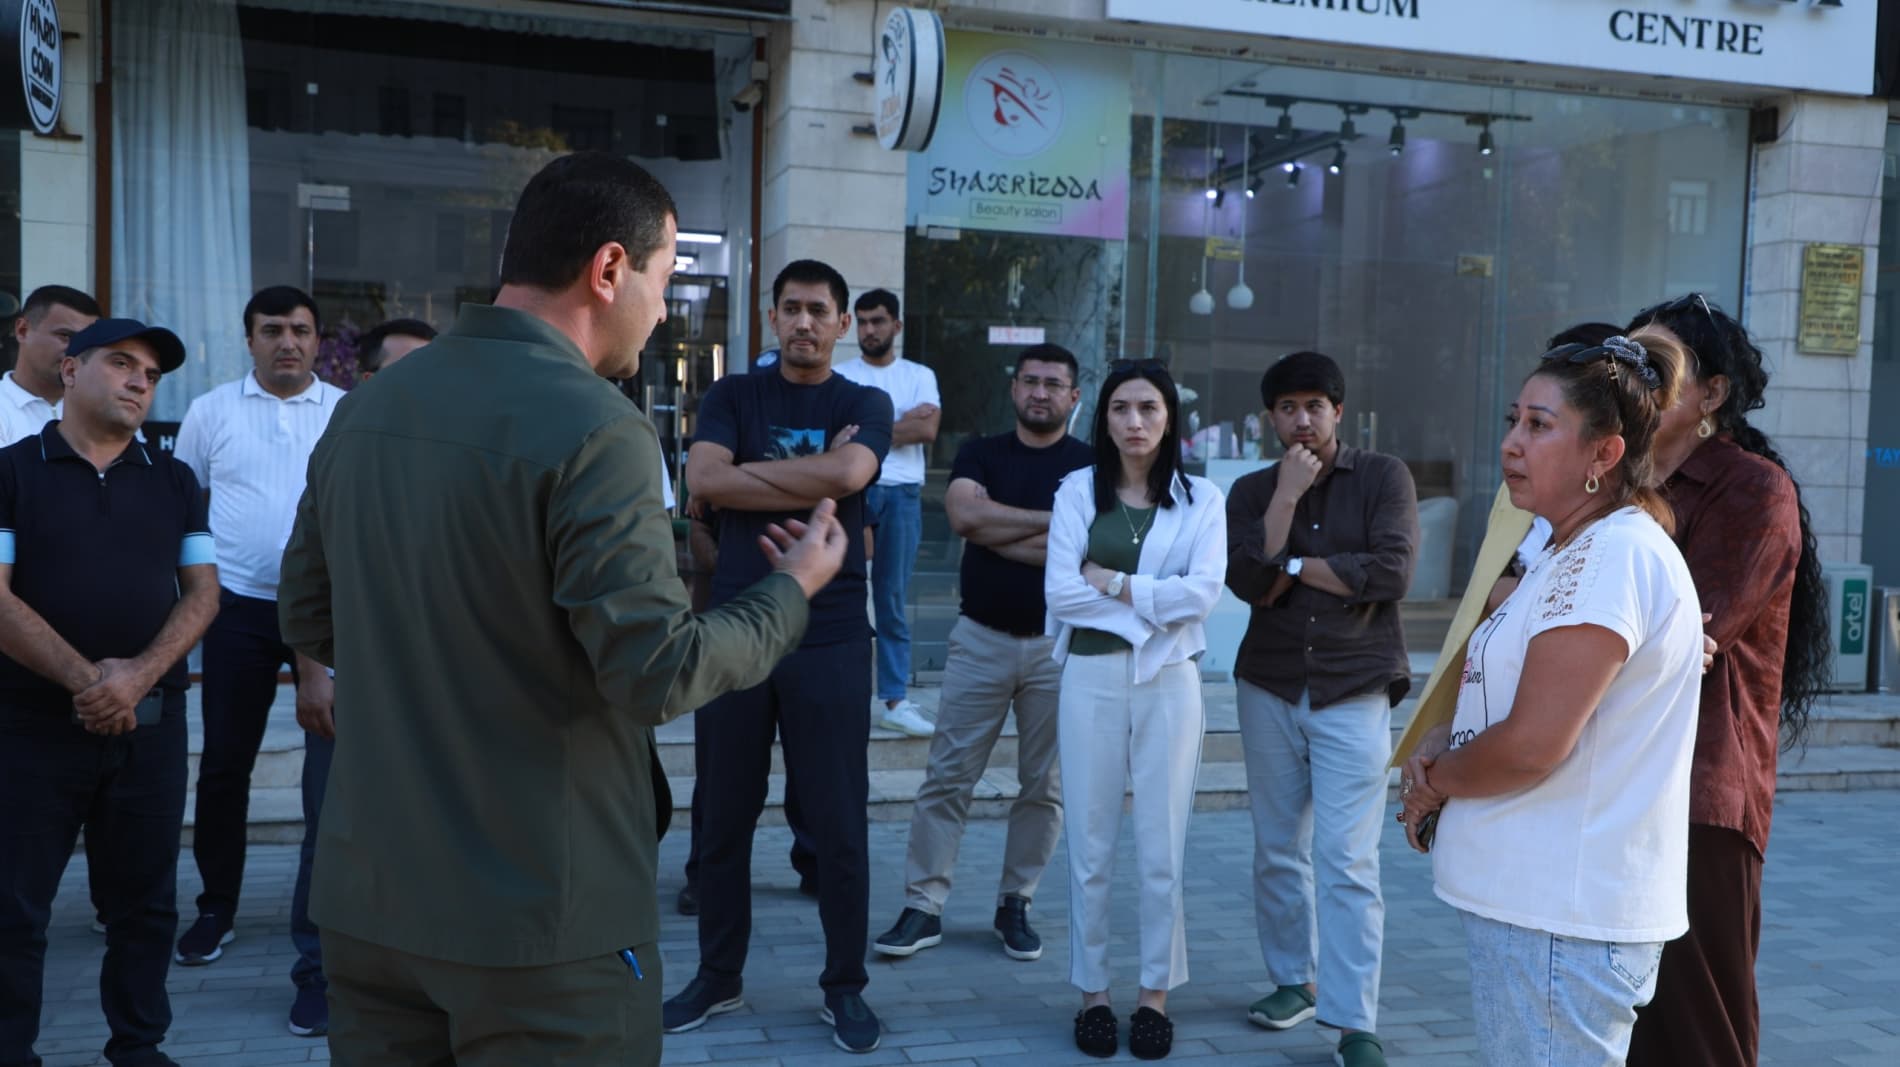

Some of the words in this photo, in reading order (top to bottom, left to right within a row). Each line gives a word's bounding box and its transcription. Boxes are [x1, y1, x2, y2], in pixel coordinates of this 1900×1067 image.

[1608, 8, 1764, 56] CENTRE
[31, 46, 54, 88] COIN
[975, 202, 1020, 218] Beauty
[1023, 206, 1057, 219] salon
[1846, 592, 1864, 641] artel
